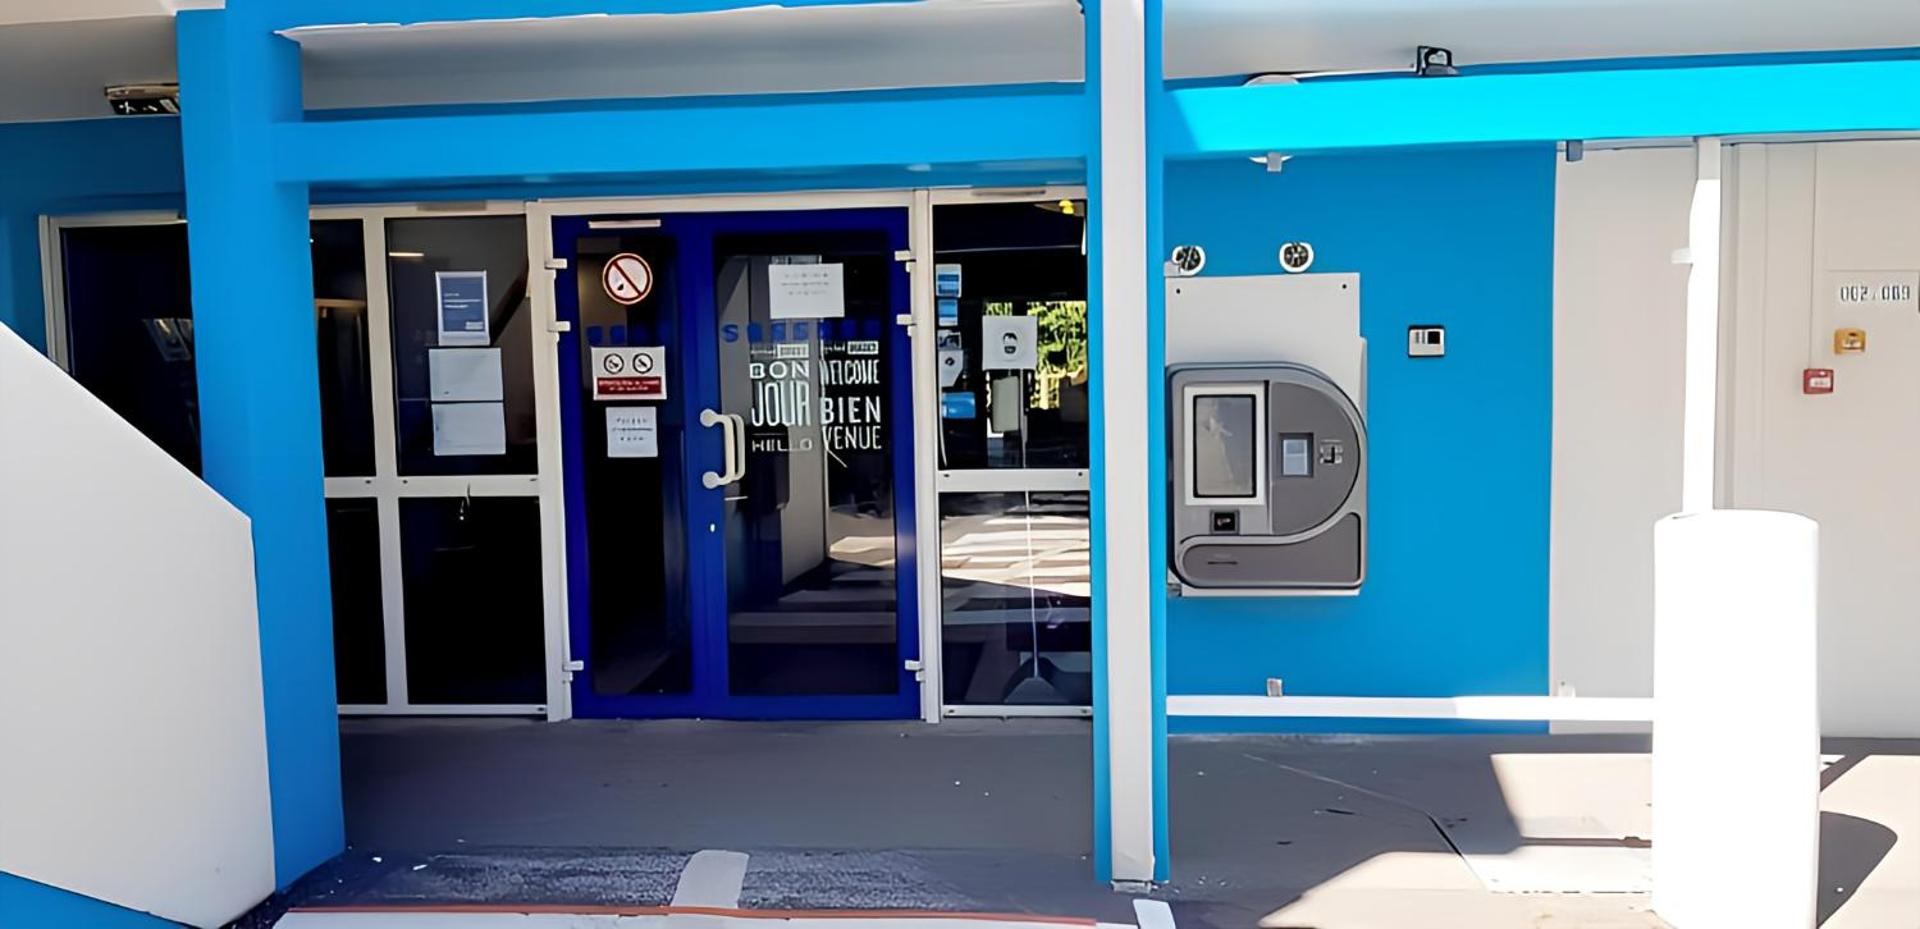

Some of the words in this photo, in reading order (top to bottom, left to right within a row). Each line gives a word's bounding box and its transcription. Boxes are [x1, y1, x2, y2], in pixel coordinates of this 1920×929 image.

[750, 360, 809, 379] BON
[819, 359, 880, 385] WELCOME
[751, 380, 811, 427] JOUR
[821, 396, 881, 424] BIEN
[822, 425, 882, 450] VENUE
